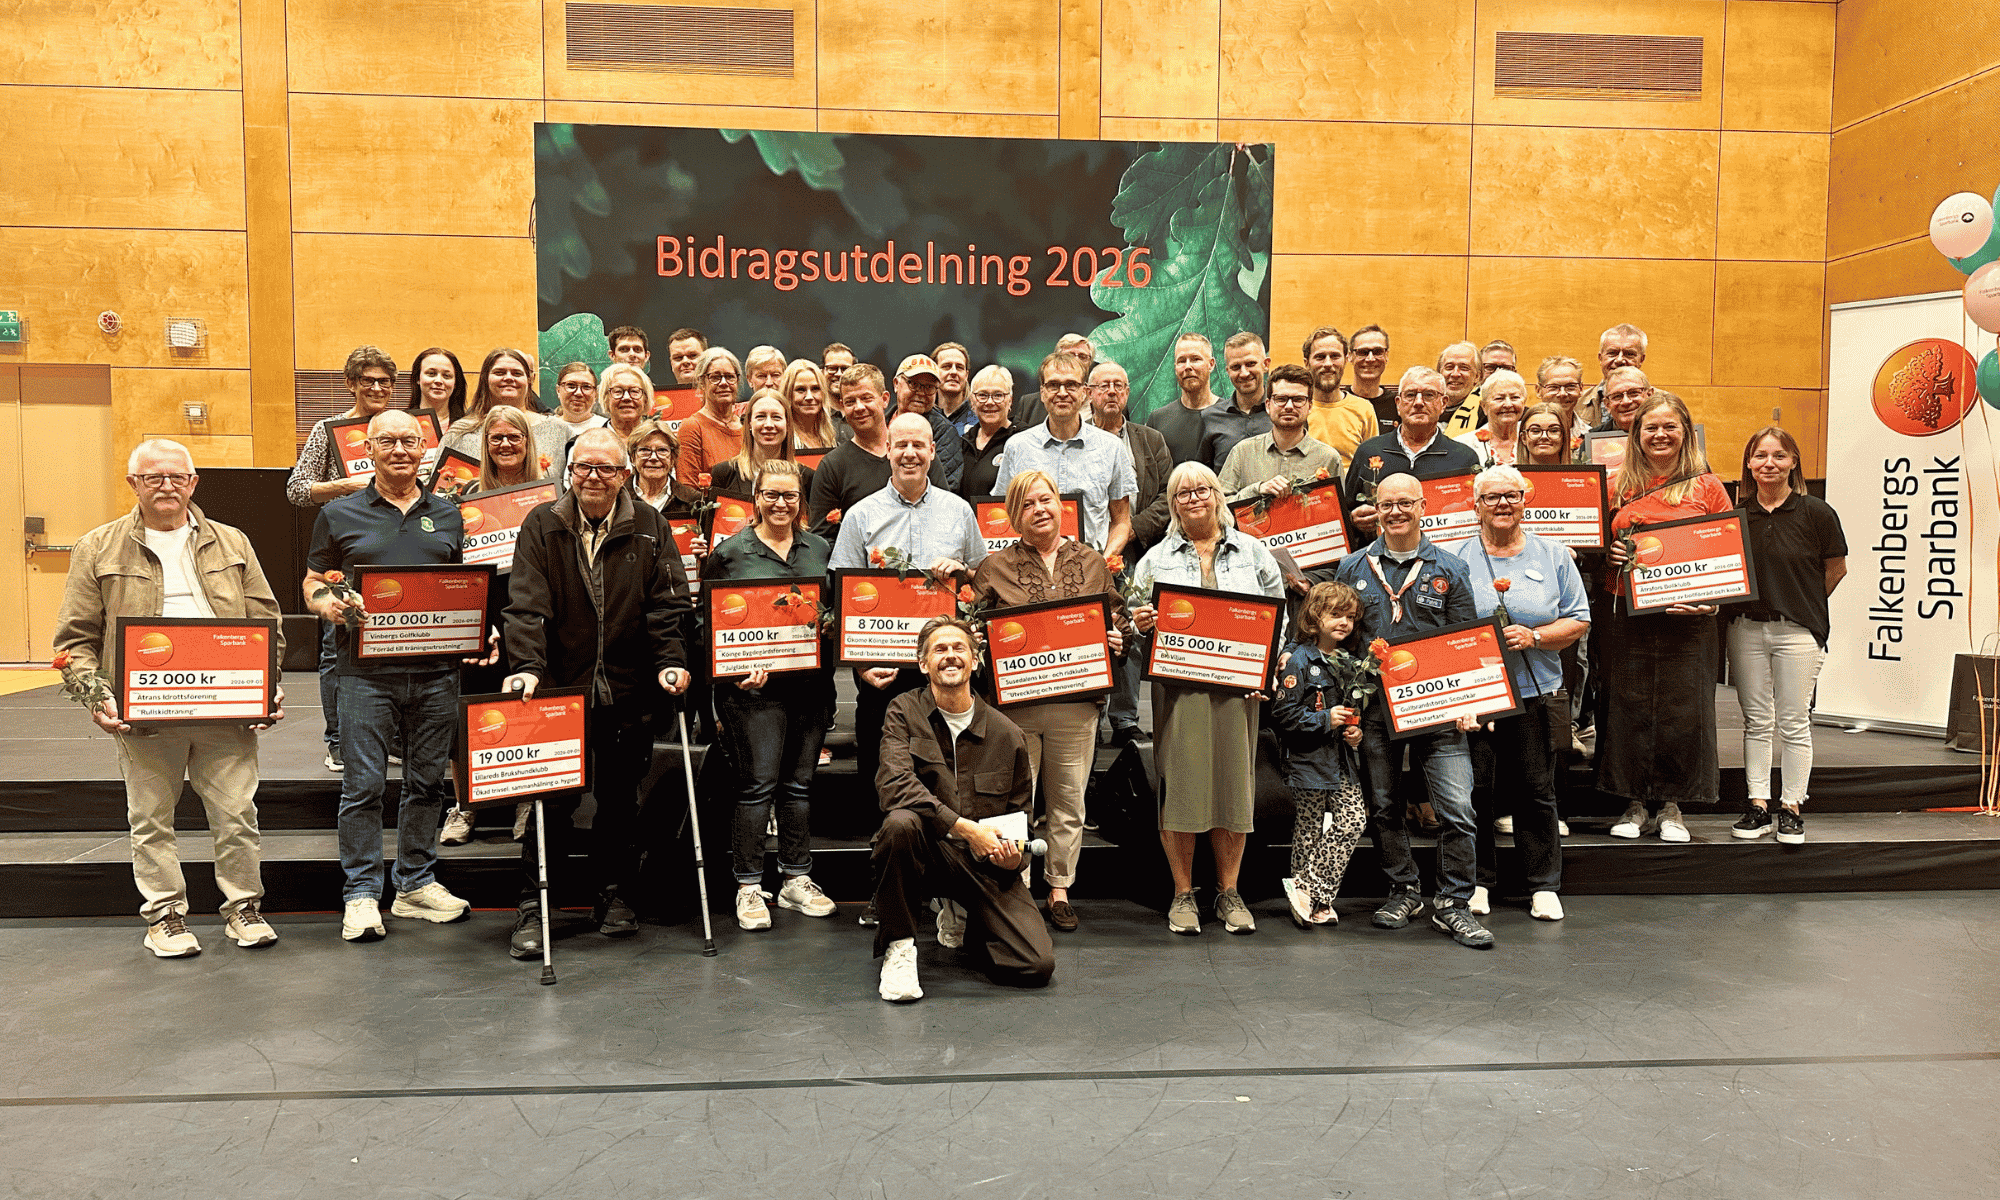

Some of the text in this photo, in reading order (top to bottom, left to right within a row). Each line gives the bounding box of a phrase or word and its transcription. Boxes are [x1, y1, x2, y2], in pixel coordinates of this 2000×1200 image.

[656, 235, 1152, 296] Bidragsutdelning 2026
[354, 461, 368, 470] 60
[1534, 510, 1556, 519] 000
[1559, 510, 1570, 519] kr
[1436, 517, 1448, 526] kr
[1693, 527, 1722, 535] Falkenbergs
[481, 533, 506, 544] 000
[1270, 534, 1293, 547] 000
[1295, 532, 1307, 540] kr
[1918, 455, 1965, 620] Sparbank
[988, 540, 1008, 549] 242
[1868, 457, 1918, 662] Falkenbergs
[1640, 562, 1708, 580] 120 000 kr
[1228, 607, 1257, 615] Falkenbergs
[372, 614, 446, 626] 120 000 kr
[858, 619, 910, 630] 8 700 kr
[722, 630, 779, 643] 14 000 kr
[1447, 636, 1476, 646] Falkenbergs
[1164, 635, 1231, 653] 185 000 kr
[1454, 641, 1477, 650] Sparbank
[1003, 652, 1072, 671] 140 000 kr
[138, 673, 216, 685] 52 000 kr
[1006, 676, 1037, 685] Susedalens
[1064, 667, 1089, 676] ridklubb
[1396, 678, 1461, 699] 25 000 kr
[479, 747, 540, 764] 19 000 kr
[475, 766, 548, 781] Ullareds Brukshundklubb
